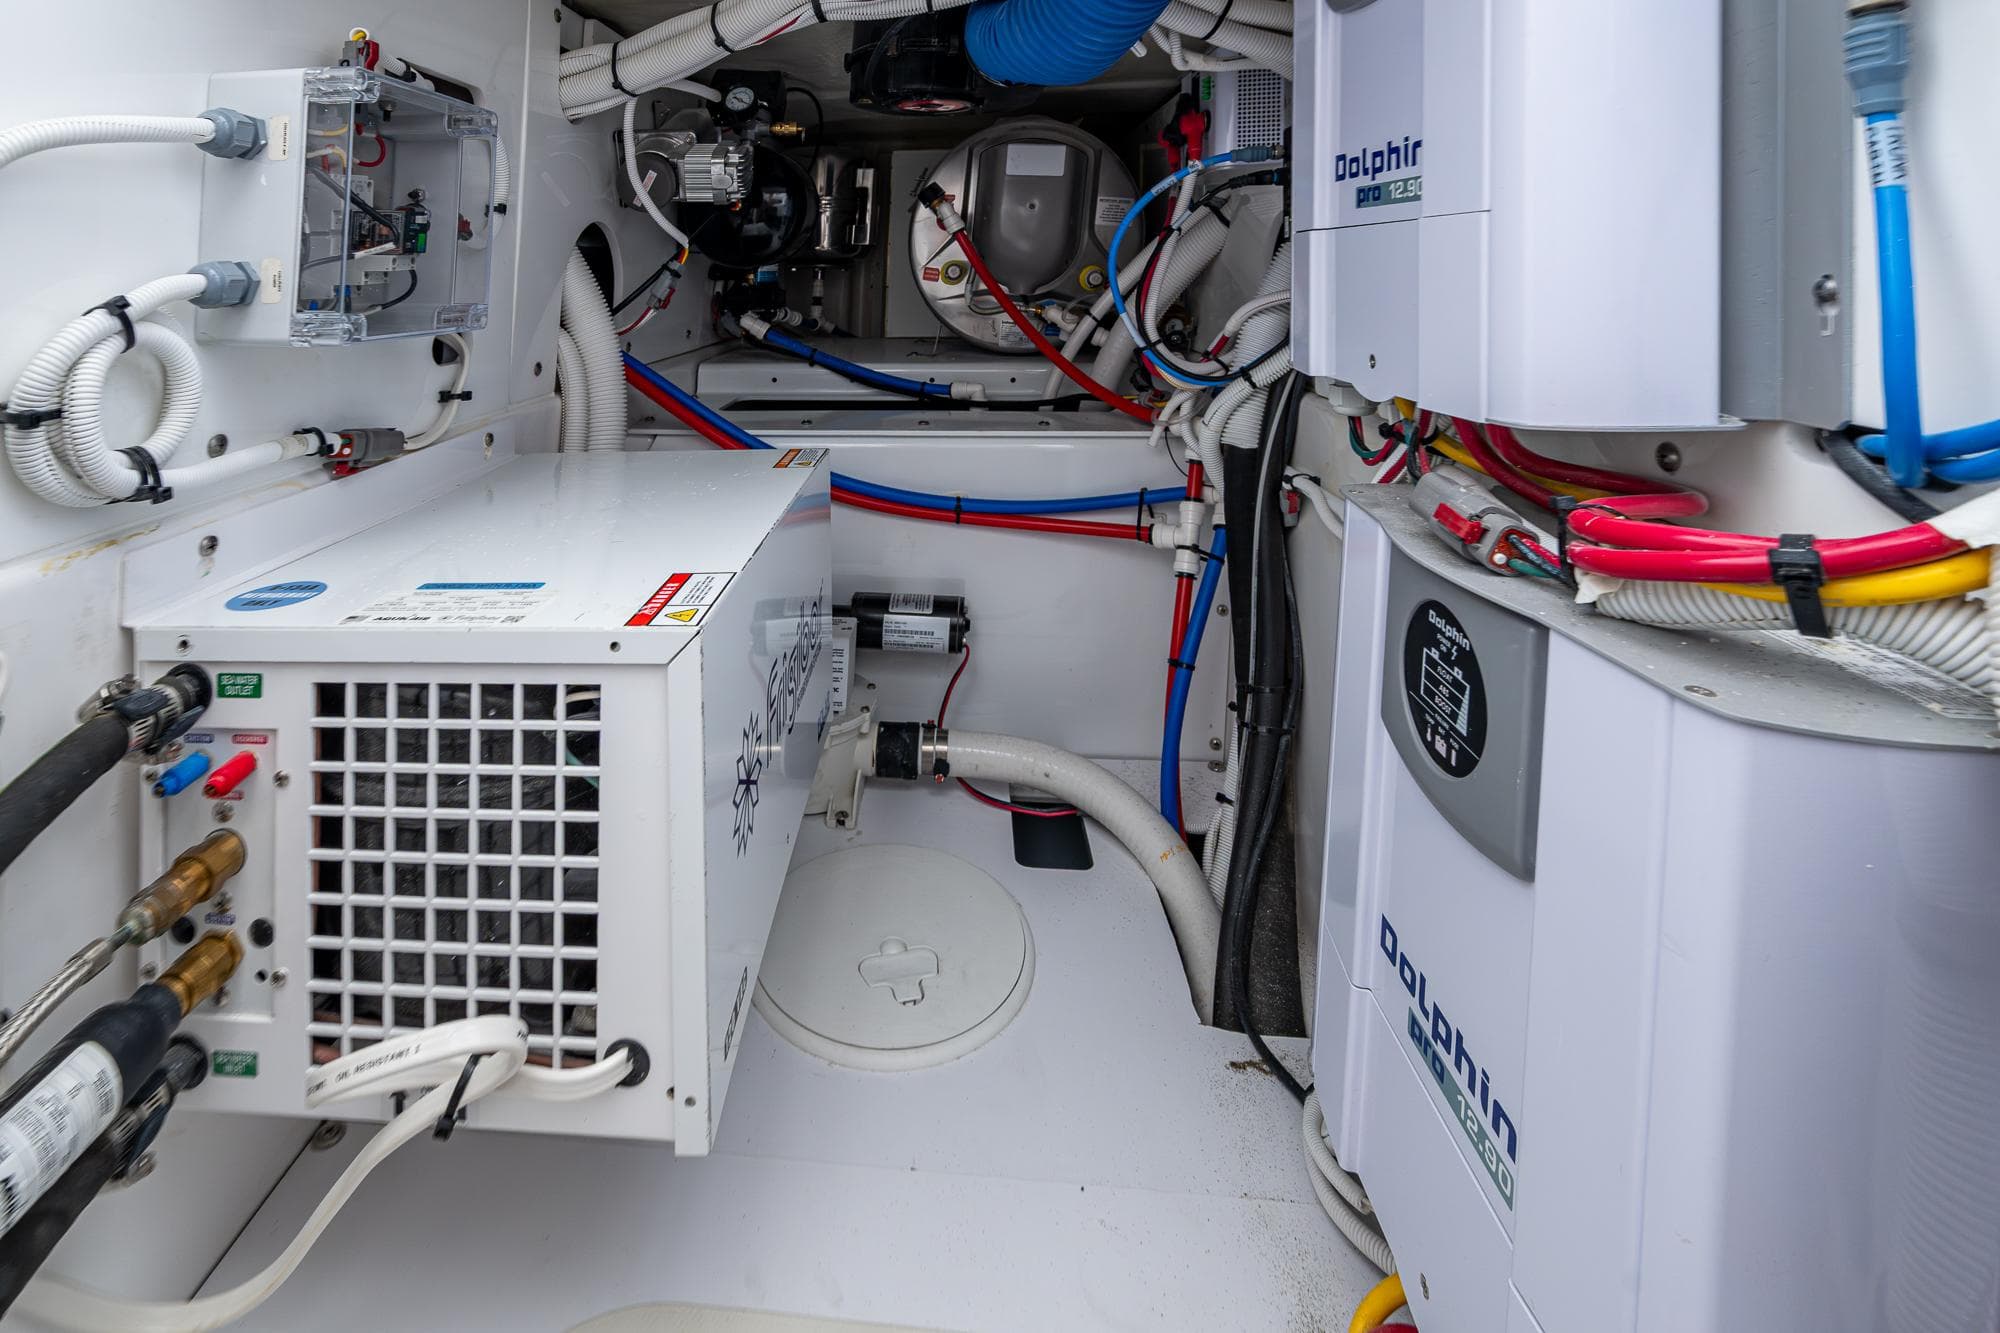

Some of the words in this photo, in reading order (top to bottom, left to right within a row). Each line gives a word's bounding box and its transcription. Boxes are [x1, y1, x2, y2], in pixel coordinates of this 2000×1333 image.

[1357, 185, 1381, 208] pro
[1428, 609, 1470, 651] Dolphin
[1380, 913, 1517, 1165] Dolphin
[1409, 1009, 1445, 1085] pro
[1456, 1094, 1512, 1198] 12.90
